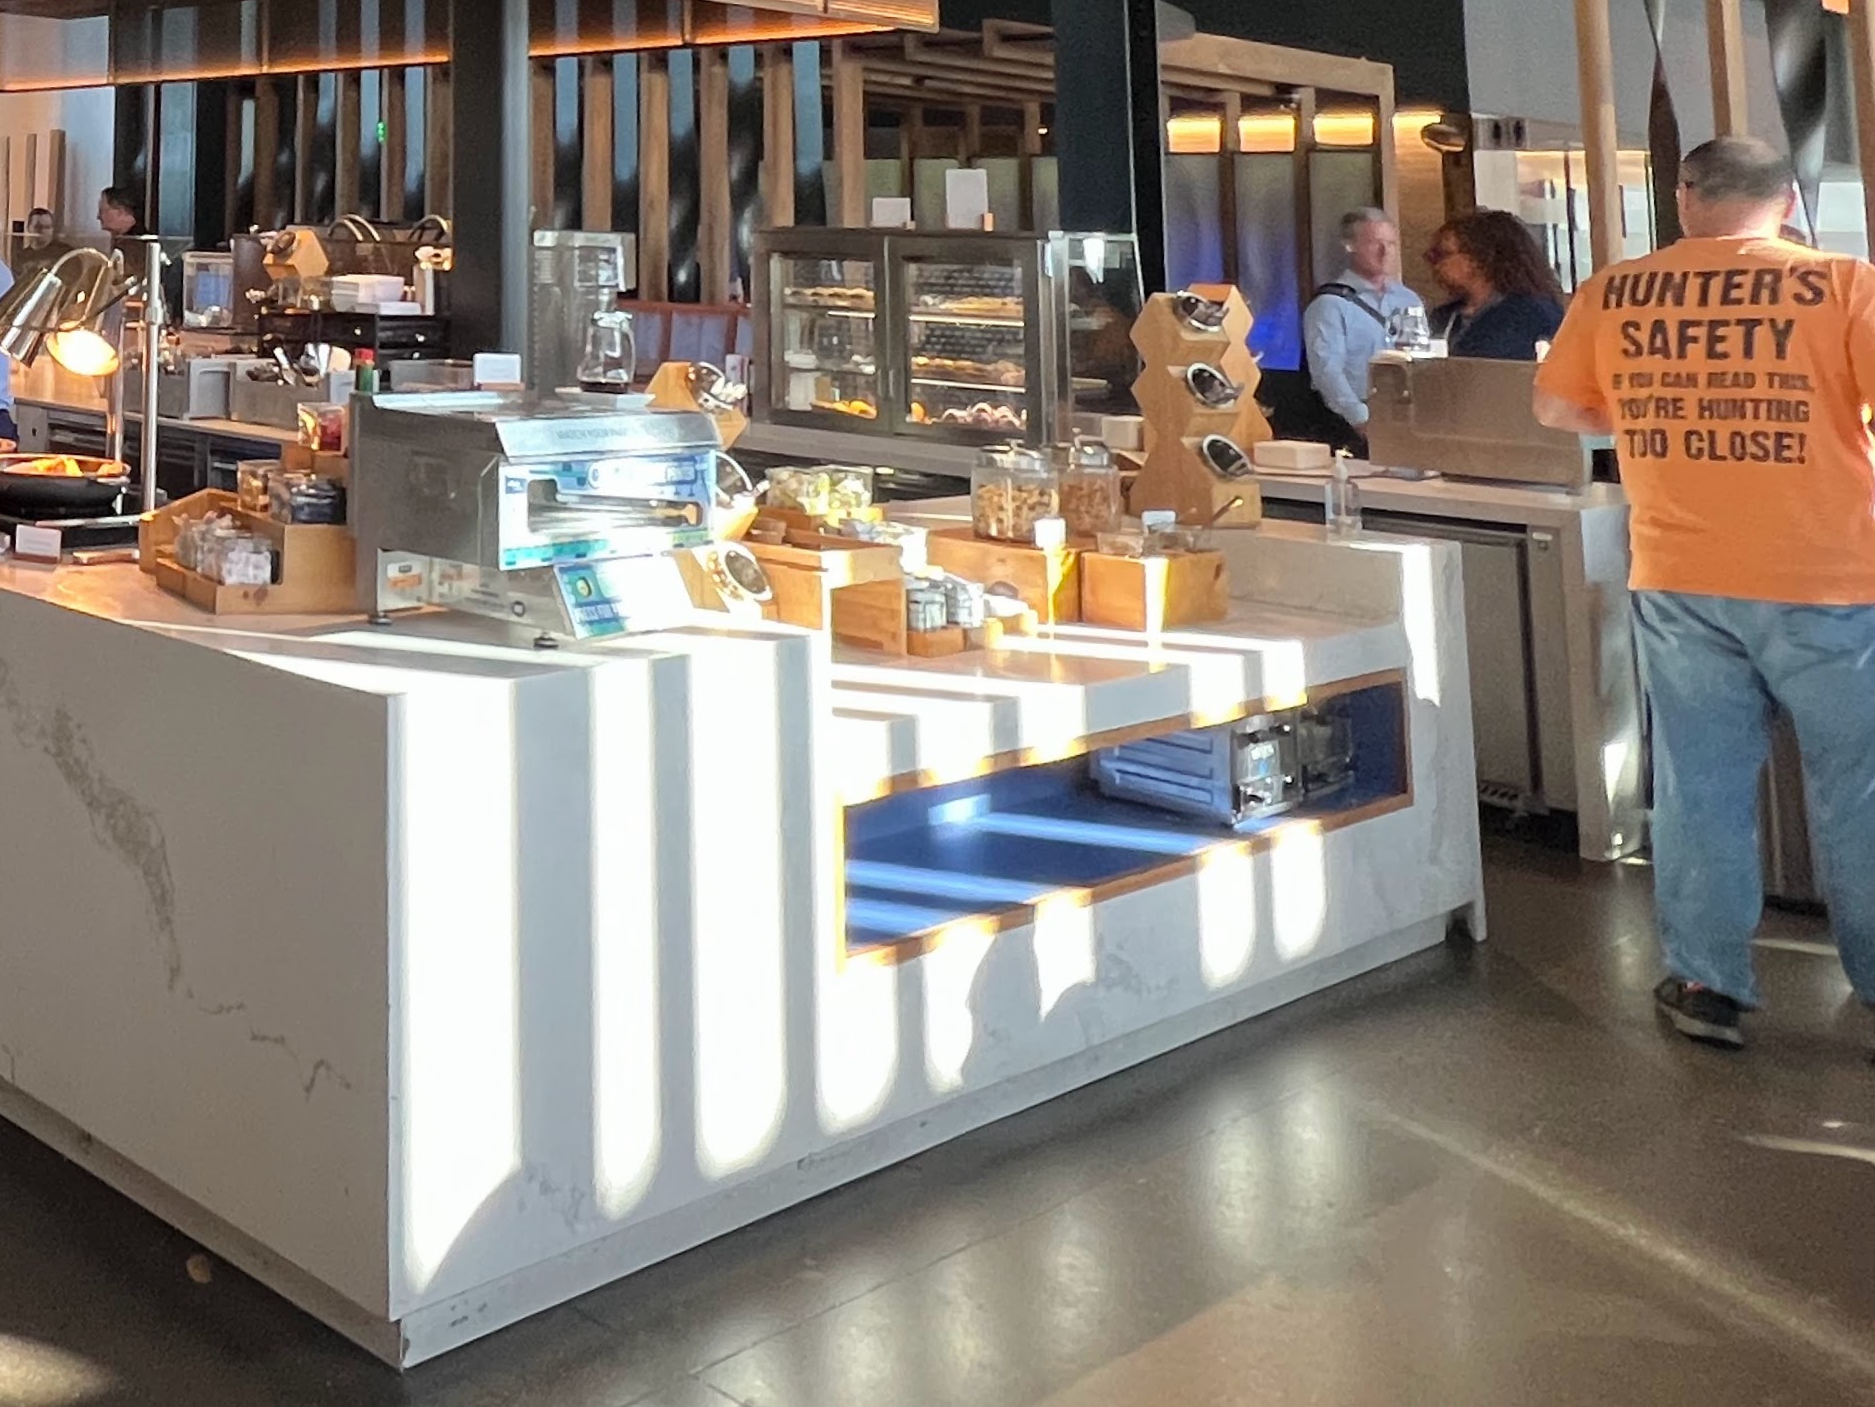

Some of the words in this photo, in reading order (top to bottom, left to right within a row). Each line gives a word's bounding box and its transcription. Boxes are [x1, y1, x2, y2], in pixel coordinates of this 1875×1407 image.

[1602, 267, 1828, 310] HUNTER'S
[1620, 318, 1795, 360] SAFETY
[1660, 372, 1699, 389] CAN
[1706, 372, 1756, 389] READ
[1697, 397, 1810, 423] HUNTING
[1623, 428, 1668, 460] TOO
[1683, 429, 1806, 465] CLOSE!
